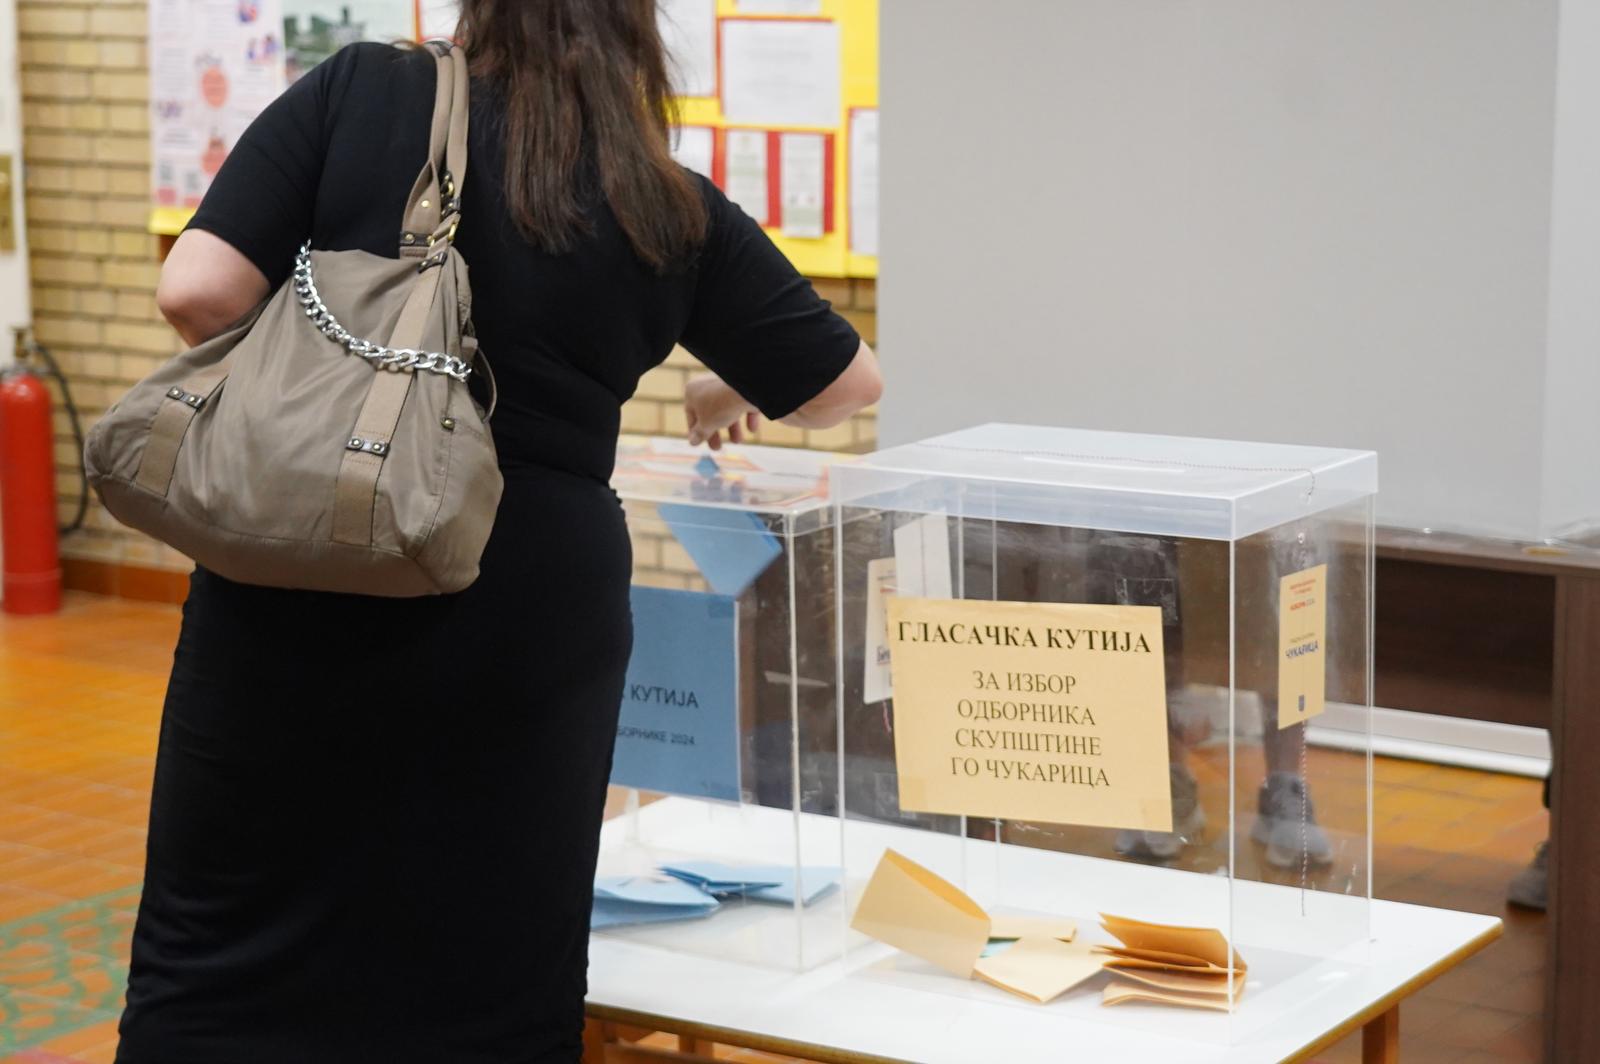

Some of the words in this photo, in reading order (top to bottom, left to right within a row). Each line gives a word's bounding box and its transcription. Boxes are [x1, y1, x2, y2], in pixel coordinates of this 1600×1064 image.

[898, 621, 1037, 648] ГЛАСАЧКА
[1047, 627, 1151, 653] КУТИЈА
[630, 683, 699, 708] КУТИЈА
[972, 670, 1000, 690] ЗА
[1006, 671, 1077, 694] ИЗБОР
[957, 698, 1096, 726] ОДБОРНИКА
[954, 727, 1102, 757] СКУПШТИНЕ
[951, 756, 979, 777] ГО
[986, 760, 1111, 788] ЧУКАРИЦА
